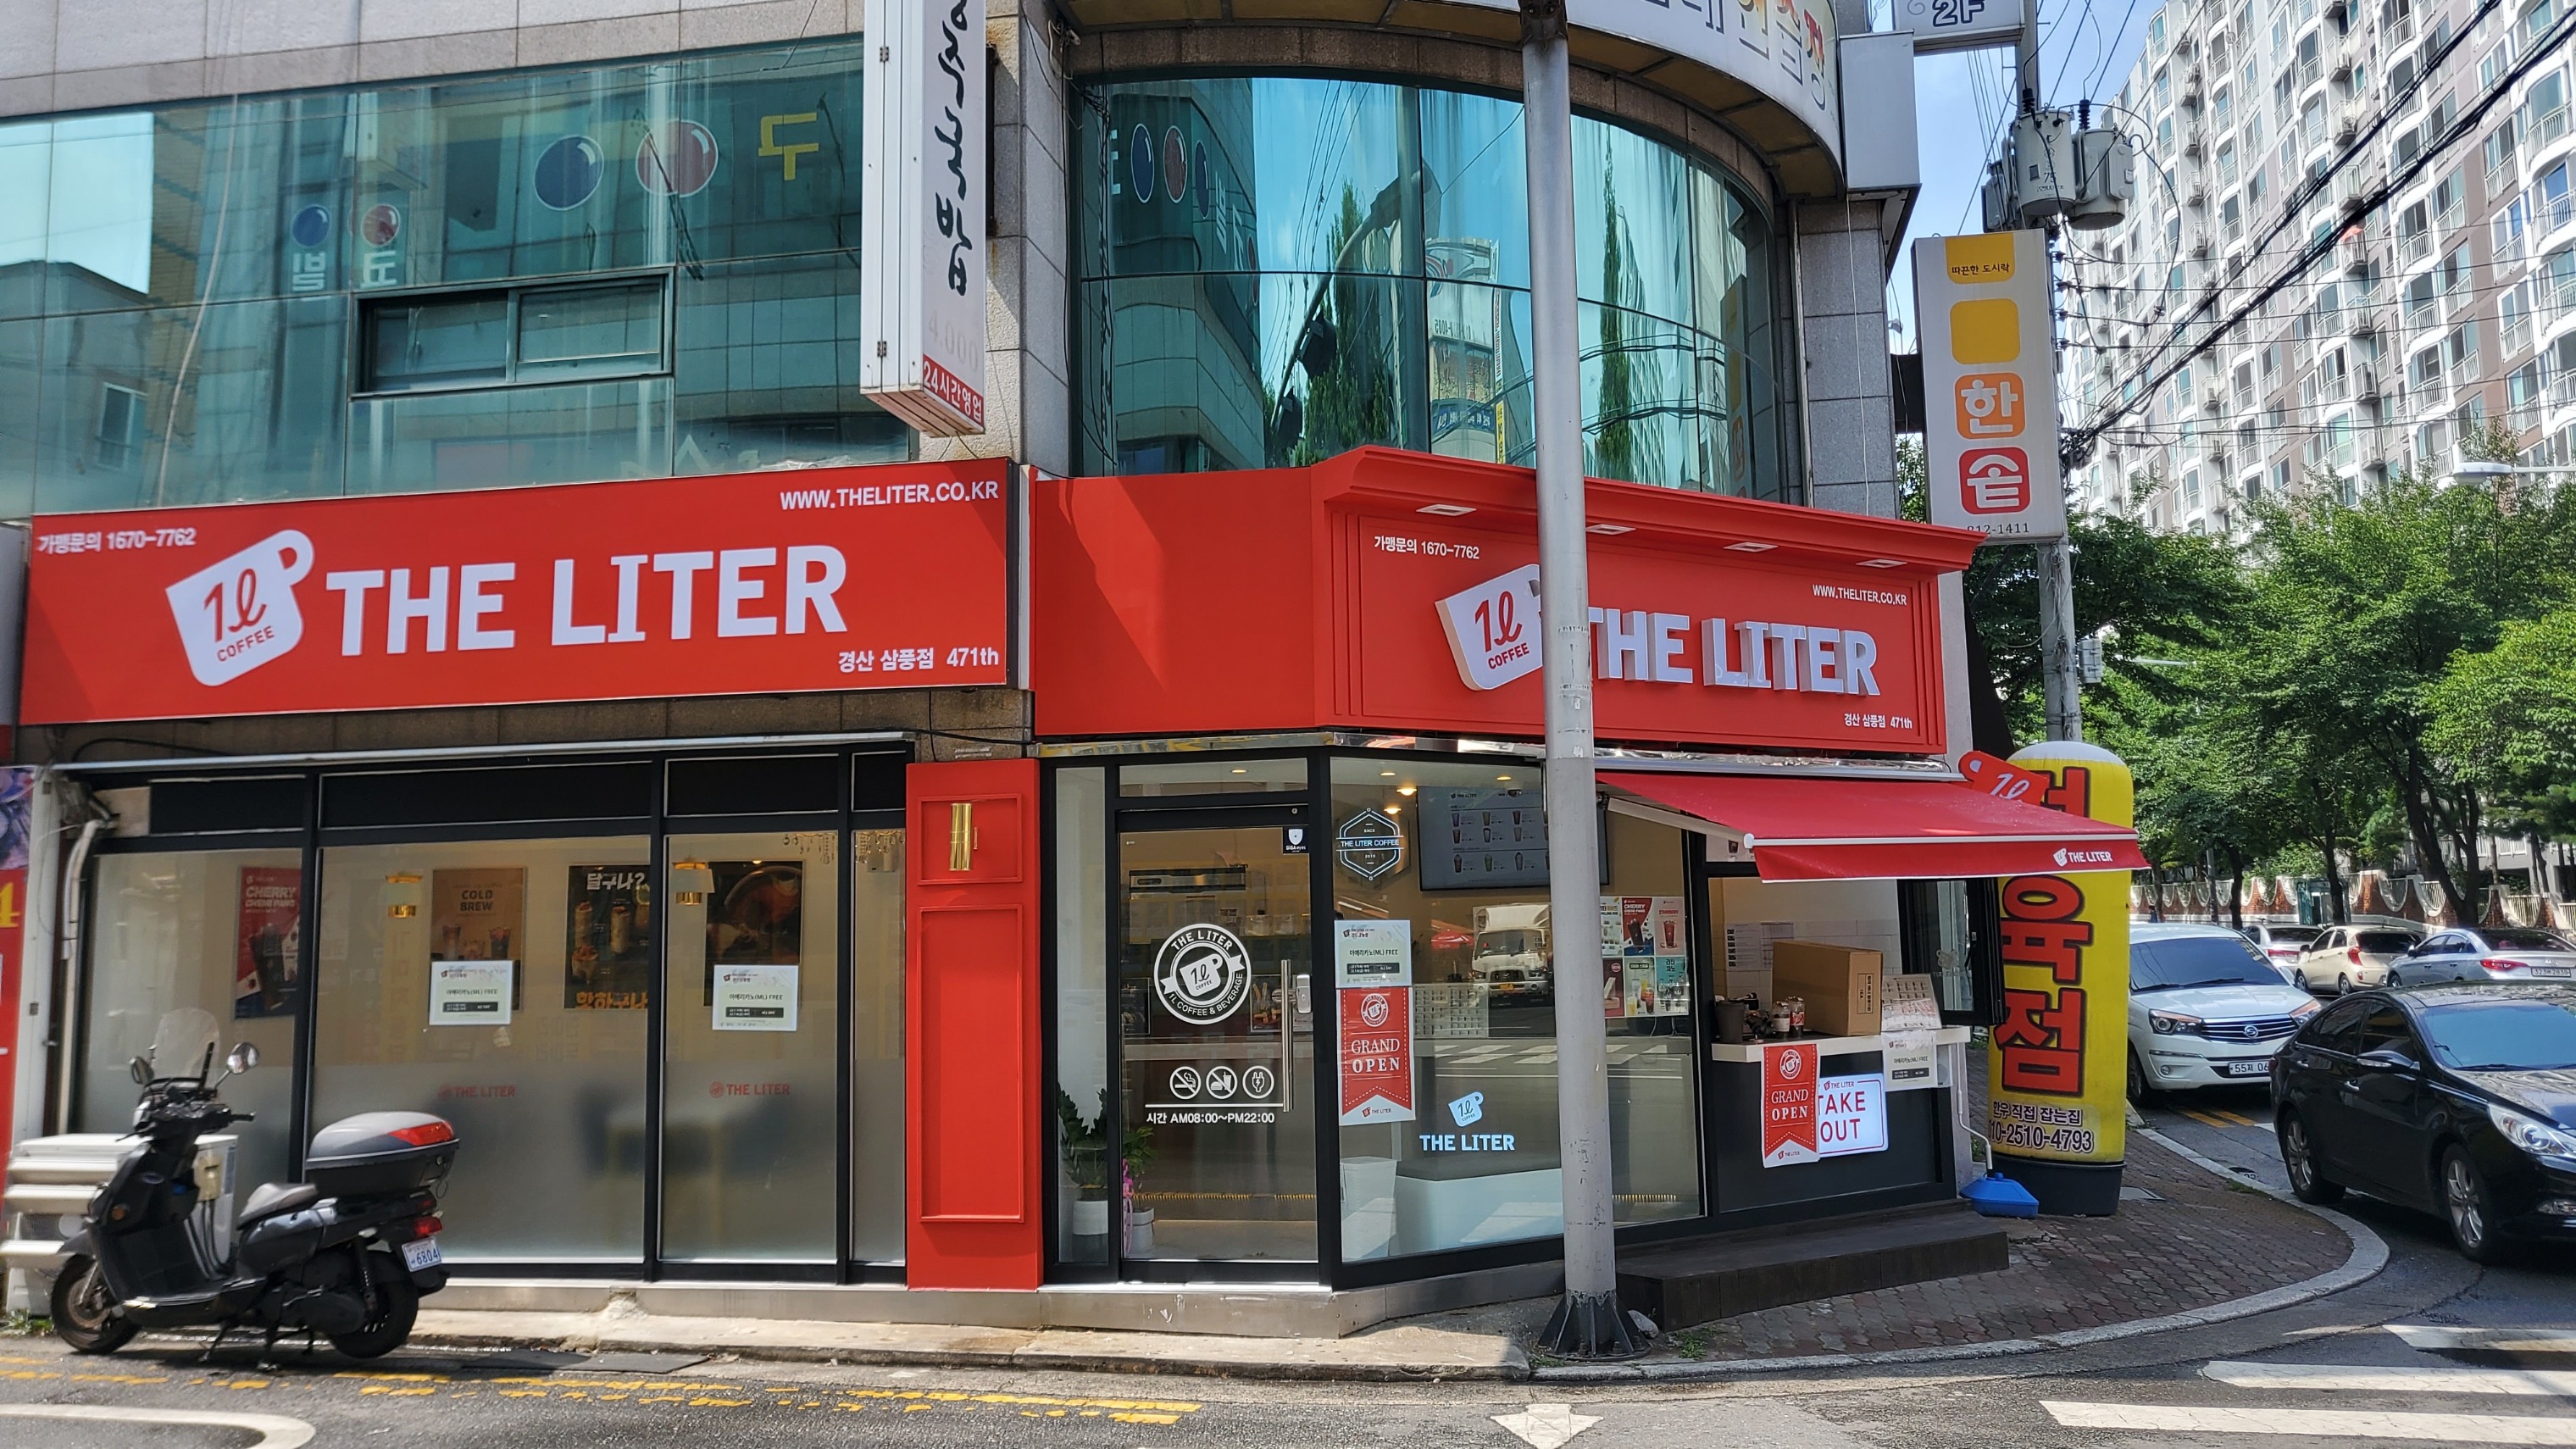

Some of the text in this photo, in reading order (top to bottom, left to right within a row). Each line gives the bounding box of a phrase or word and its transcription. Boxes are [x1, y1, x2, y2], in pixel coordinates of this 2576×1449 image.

[1933, 0, 1985, 26] 2F
[934, 0, 973, 297] 주국밥
[1951, 263, 2009, 275] 따끈한 도시락
[924, 361, 981, 422] 24시간영업
[780, 481, 998, 510] WWW.THELITER.CO.KR
[38, 528, 197, 554] 가맹문의 1670-7762
[1374, 536, 1480, 559] 가맹문의 1670-7762
[326, 545, 848, 656] THE LITER
[1813, 584, 1907, 606] WWW.THELITER.CO.KR
[216, 625, 275, 663] COFFEE
[838, 646, 999, 674] 경산 삼풍점 471th
[1488, 642, 1530, 670] COFFEE
[1702, 618, 1881, 696] LITER
[1844, 713, 1913, 729] 경산 삼풍점 471th
[2068, 851, 2112, 863] THE LITER
[246, 886, 297, 899] CHERRY
[461, 890, 493, 900] COLD
[460, 902, 493, 912] BREW
[1171, 930, 1233, 951] THE LITER
[1177, 1001, 1208, 1016] COFFEE
[1209, 1007, 1216, 1015] &
[1216, 973, 1243, 1012] BEVERAGE
[1196, 980, 1213, 991] COFFEE
[1351, 1038, 1400, 1054] GRAND
[1352, 1057, 1400, 1074] OPEN
[453, 1085, 515, 1098] THE LITER
[726, 1083, 790, 1096] THE LITER
[1771, 1089, 1808, 1104] GRAND
[1146, 1112, 1275, 1124] 시간 AM08:00~PM22:00
[1771, 1105, 1808, 1121] OPEN
[2012, 1104, 2035, 1122] 직접
[2040, 1107, 2080, 1124] 잡는집
[1820, 1119, 1861, 1142] OUT
[1419, 1134, 1515, 1151] THE LITER
